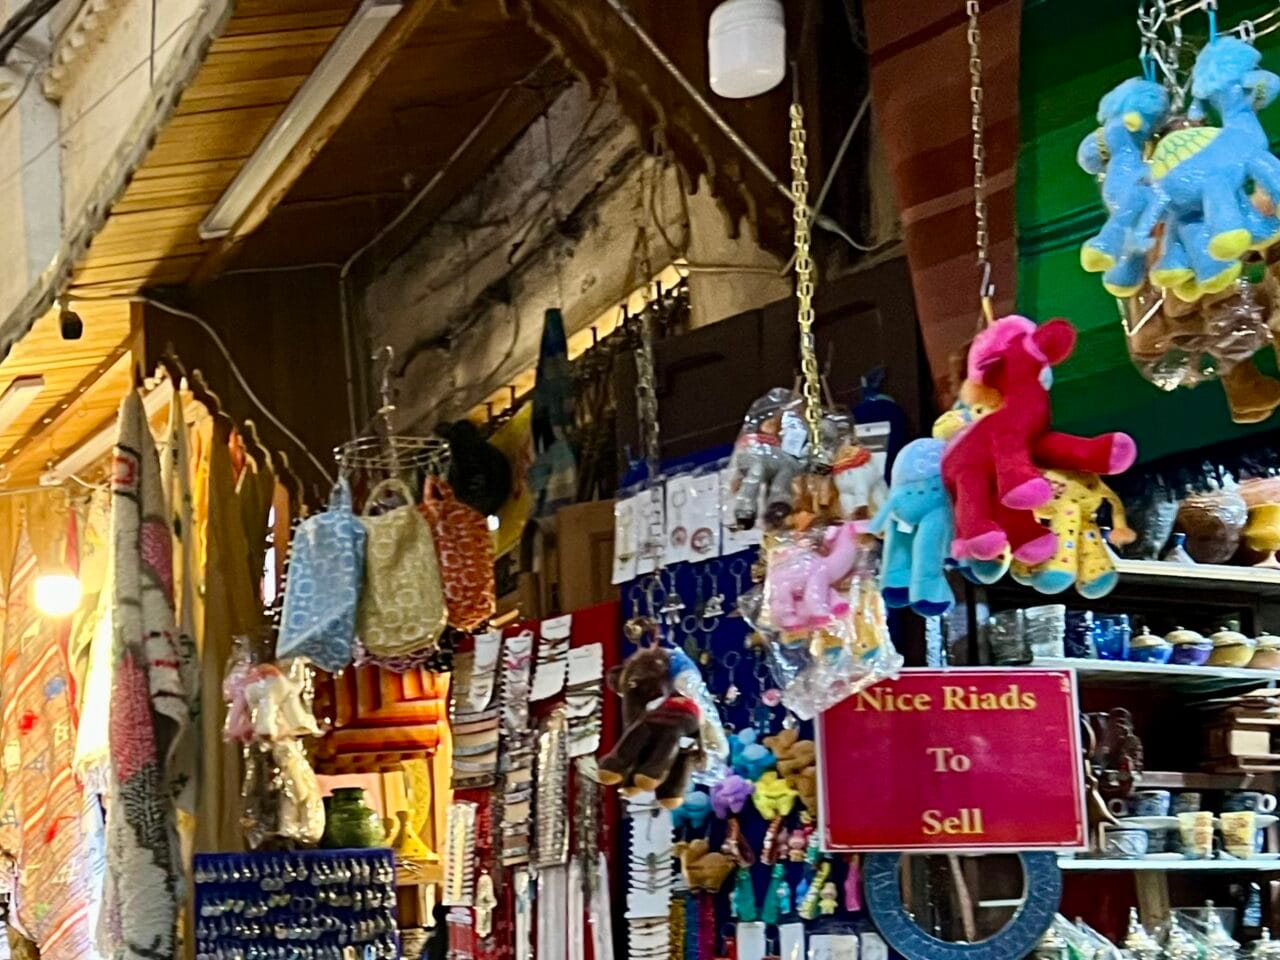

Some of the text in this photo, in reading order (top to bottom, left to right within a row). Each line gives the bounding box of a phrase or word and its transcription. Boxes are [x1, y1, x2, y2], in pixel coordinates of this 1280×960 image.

[854, 685, 1037, 712] Nice Riads
[926, 747, 971, 773] To
[922, 808, 984, 835] Sell
